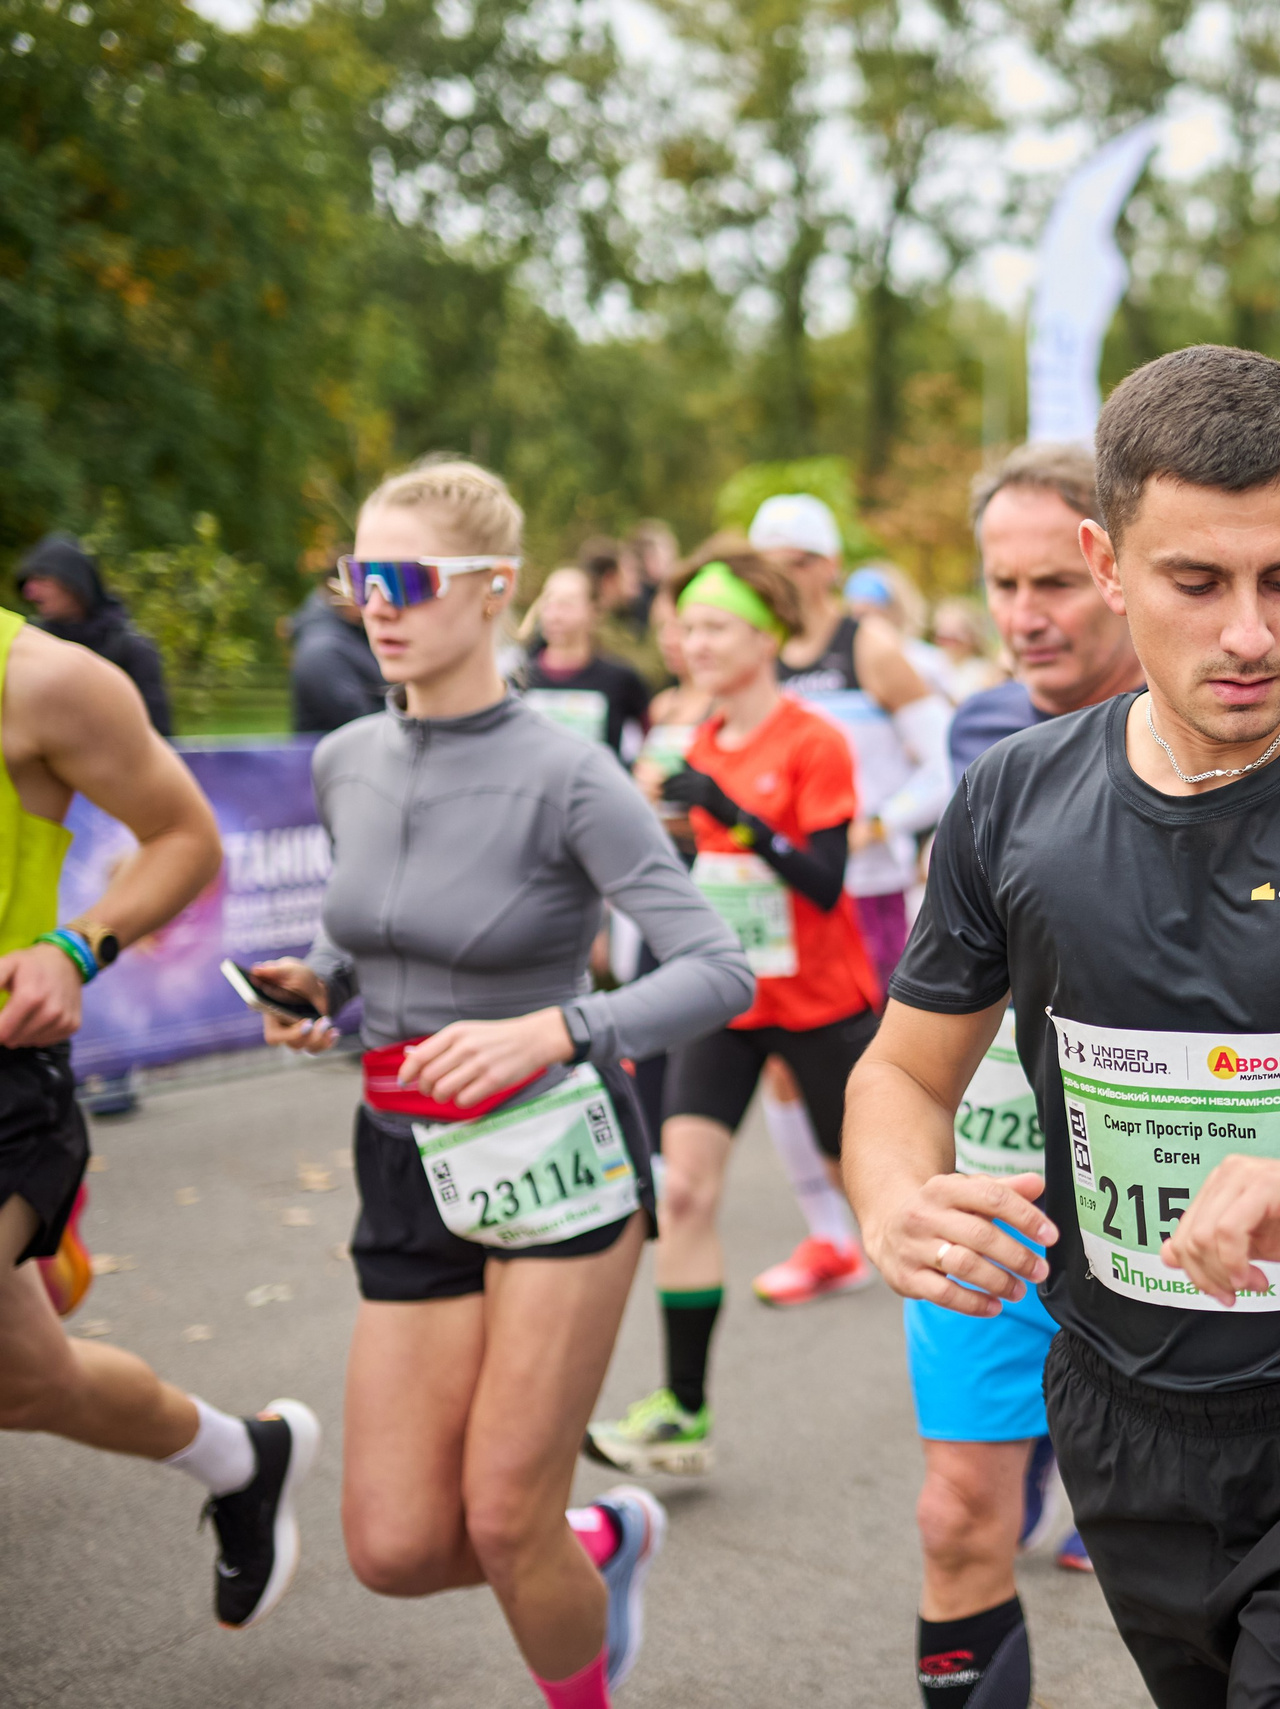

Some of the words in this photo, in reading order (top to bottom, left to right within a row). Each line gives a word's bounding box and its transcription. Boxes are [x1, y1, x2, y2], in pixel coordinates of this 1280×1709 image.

[1091, 1044, 1149, 1061] UNDER
[1097, 1088, 1149, 1103] КИЇВСЬКИЙ
[1151, 1094, 1207, 1105] МАРАФОН
[1104, 1113, 1142, 1136] Смарт
[1146, 1120, 1203, 1140] Простір
[1208, 1122, 1256, 1139] GoRun
[1153, 1148, 1200, 1165] Євген
[470, 1151, 596, 1228] 23114
[1099, 1175, 1190, 1247] 215
